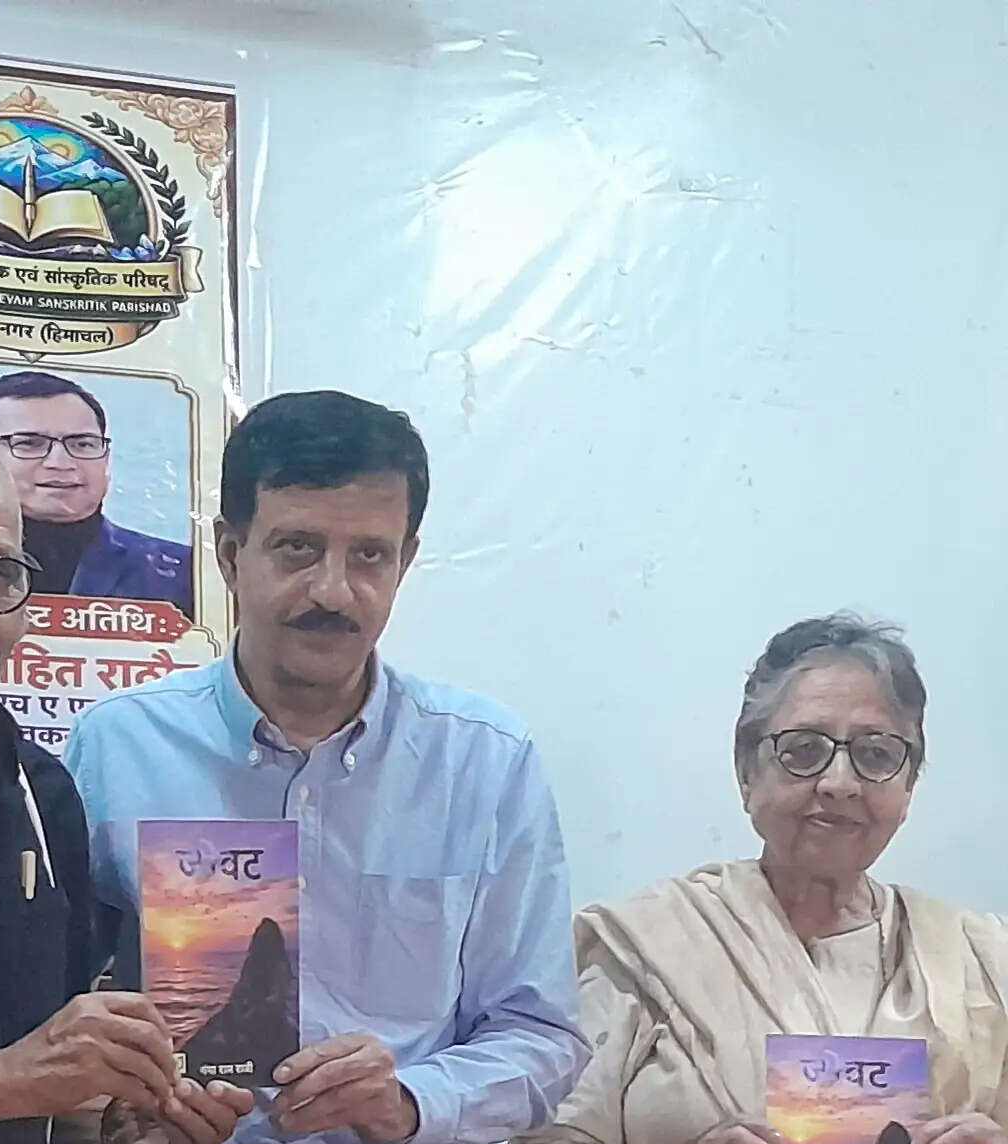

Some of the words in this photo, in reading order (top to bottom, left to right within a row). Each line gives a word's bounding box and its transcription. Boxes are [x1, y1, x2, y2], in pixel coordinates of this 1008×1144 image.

[15, 265, 39, 283] एवं
[38, 297, 108, 312] SANSKRITIK
[112, 301, 171, 313] PARISHAD
